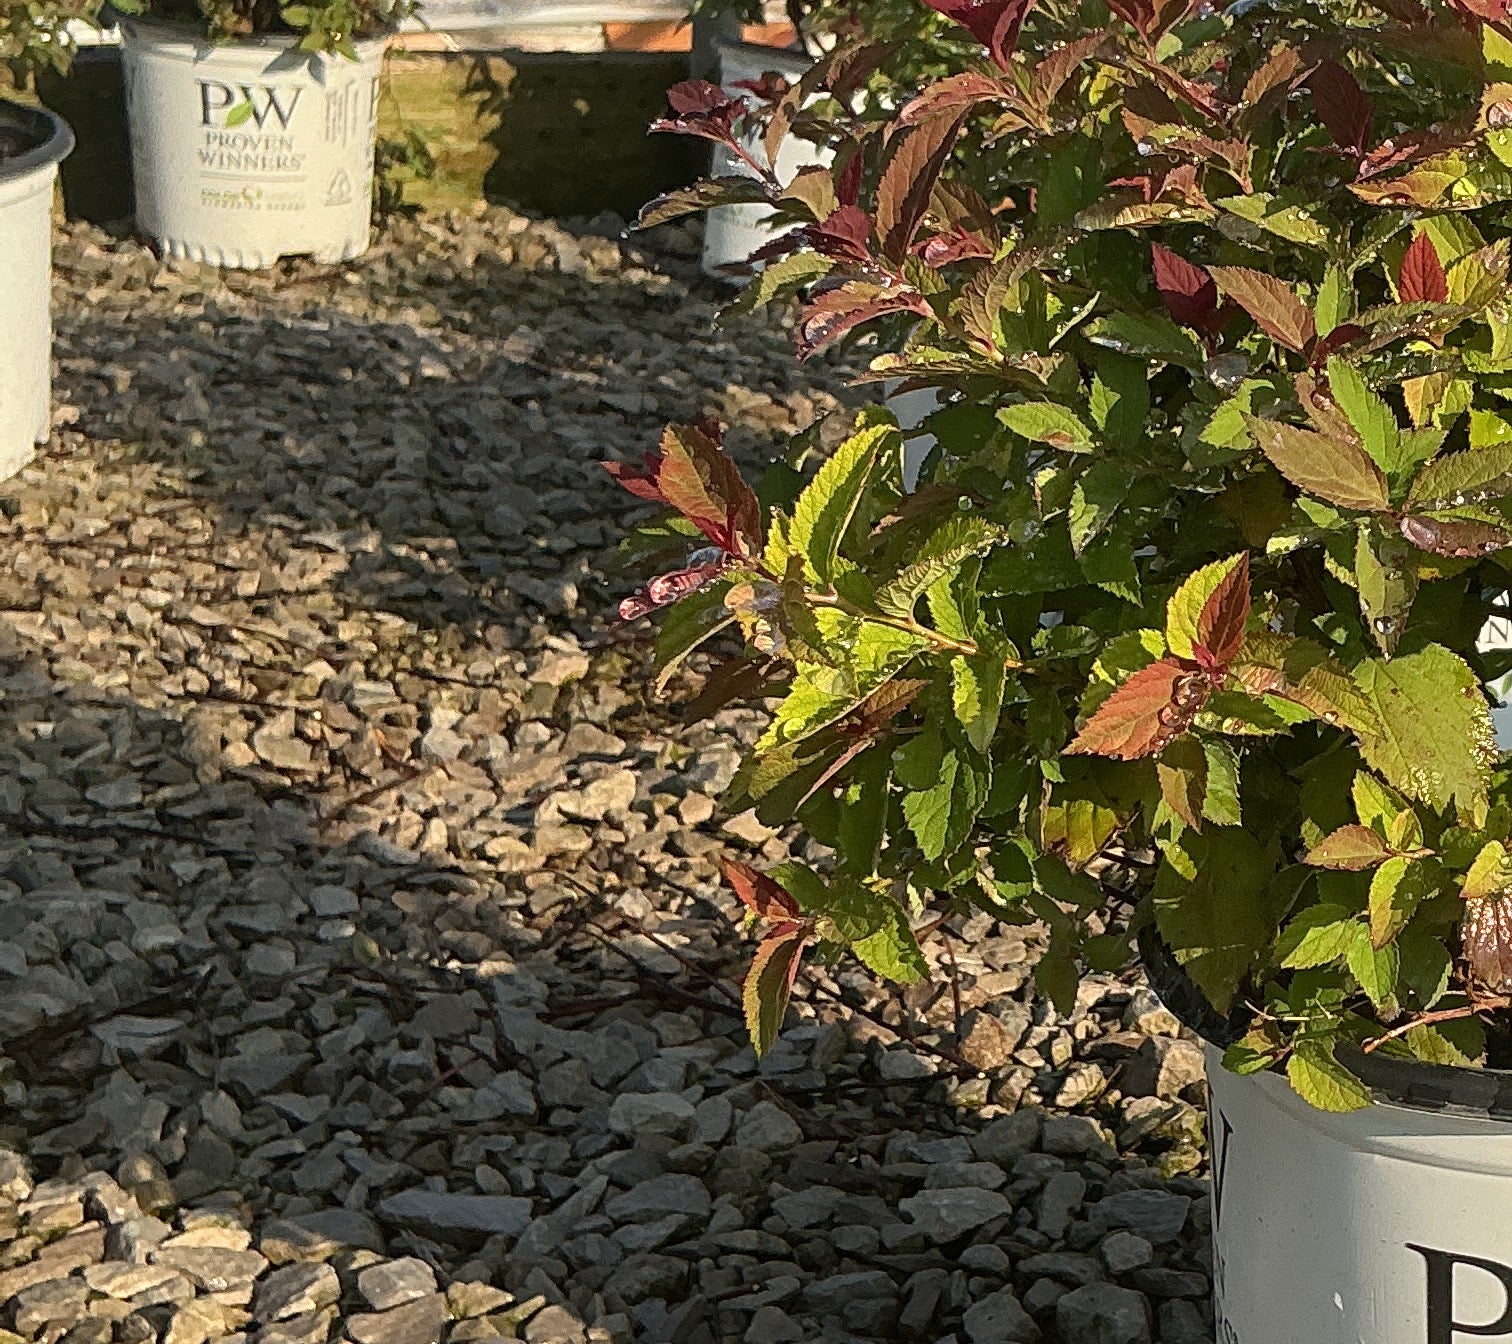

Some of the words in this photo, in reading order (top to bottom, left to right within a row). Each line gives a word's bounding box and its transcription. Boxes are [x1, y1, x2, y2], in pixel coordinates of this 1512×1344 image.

[195, 78, 308, 131] PW
[205, 131, 295, 152] PROVEN
[196, 148, 305, 172] WINNERS
